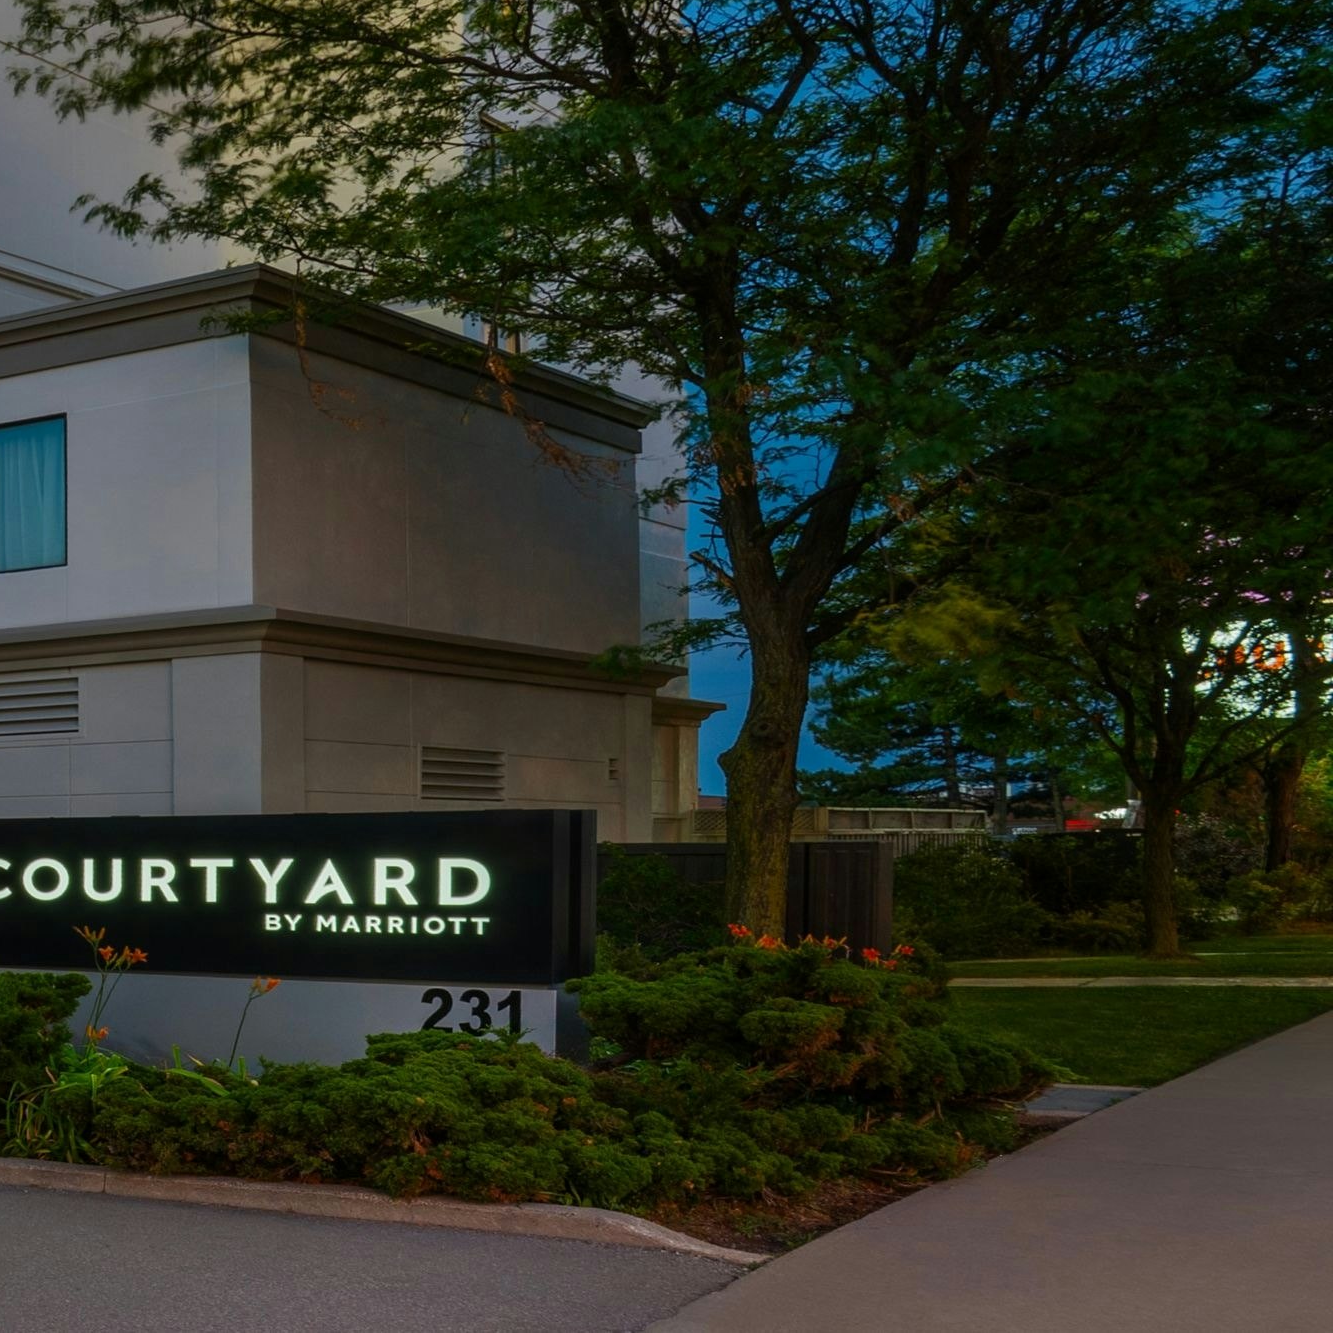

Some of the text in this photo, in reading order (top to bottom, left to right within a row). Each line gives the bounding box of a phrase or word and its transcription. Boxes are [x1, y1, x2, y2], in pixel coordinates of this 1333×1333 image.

[264, 913, 491, 936] BY MARRIOTT
[421, 988, 522, 1037] 231
